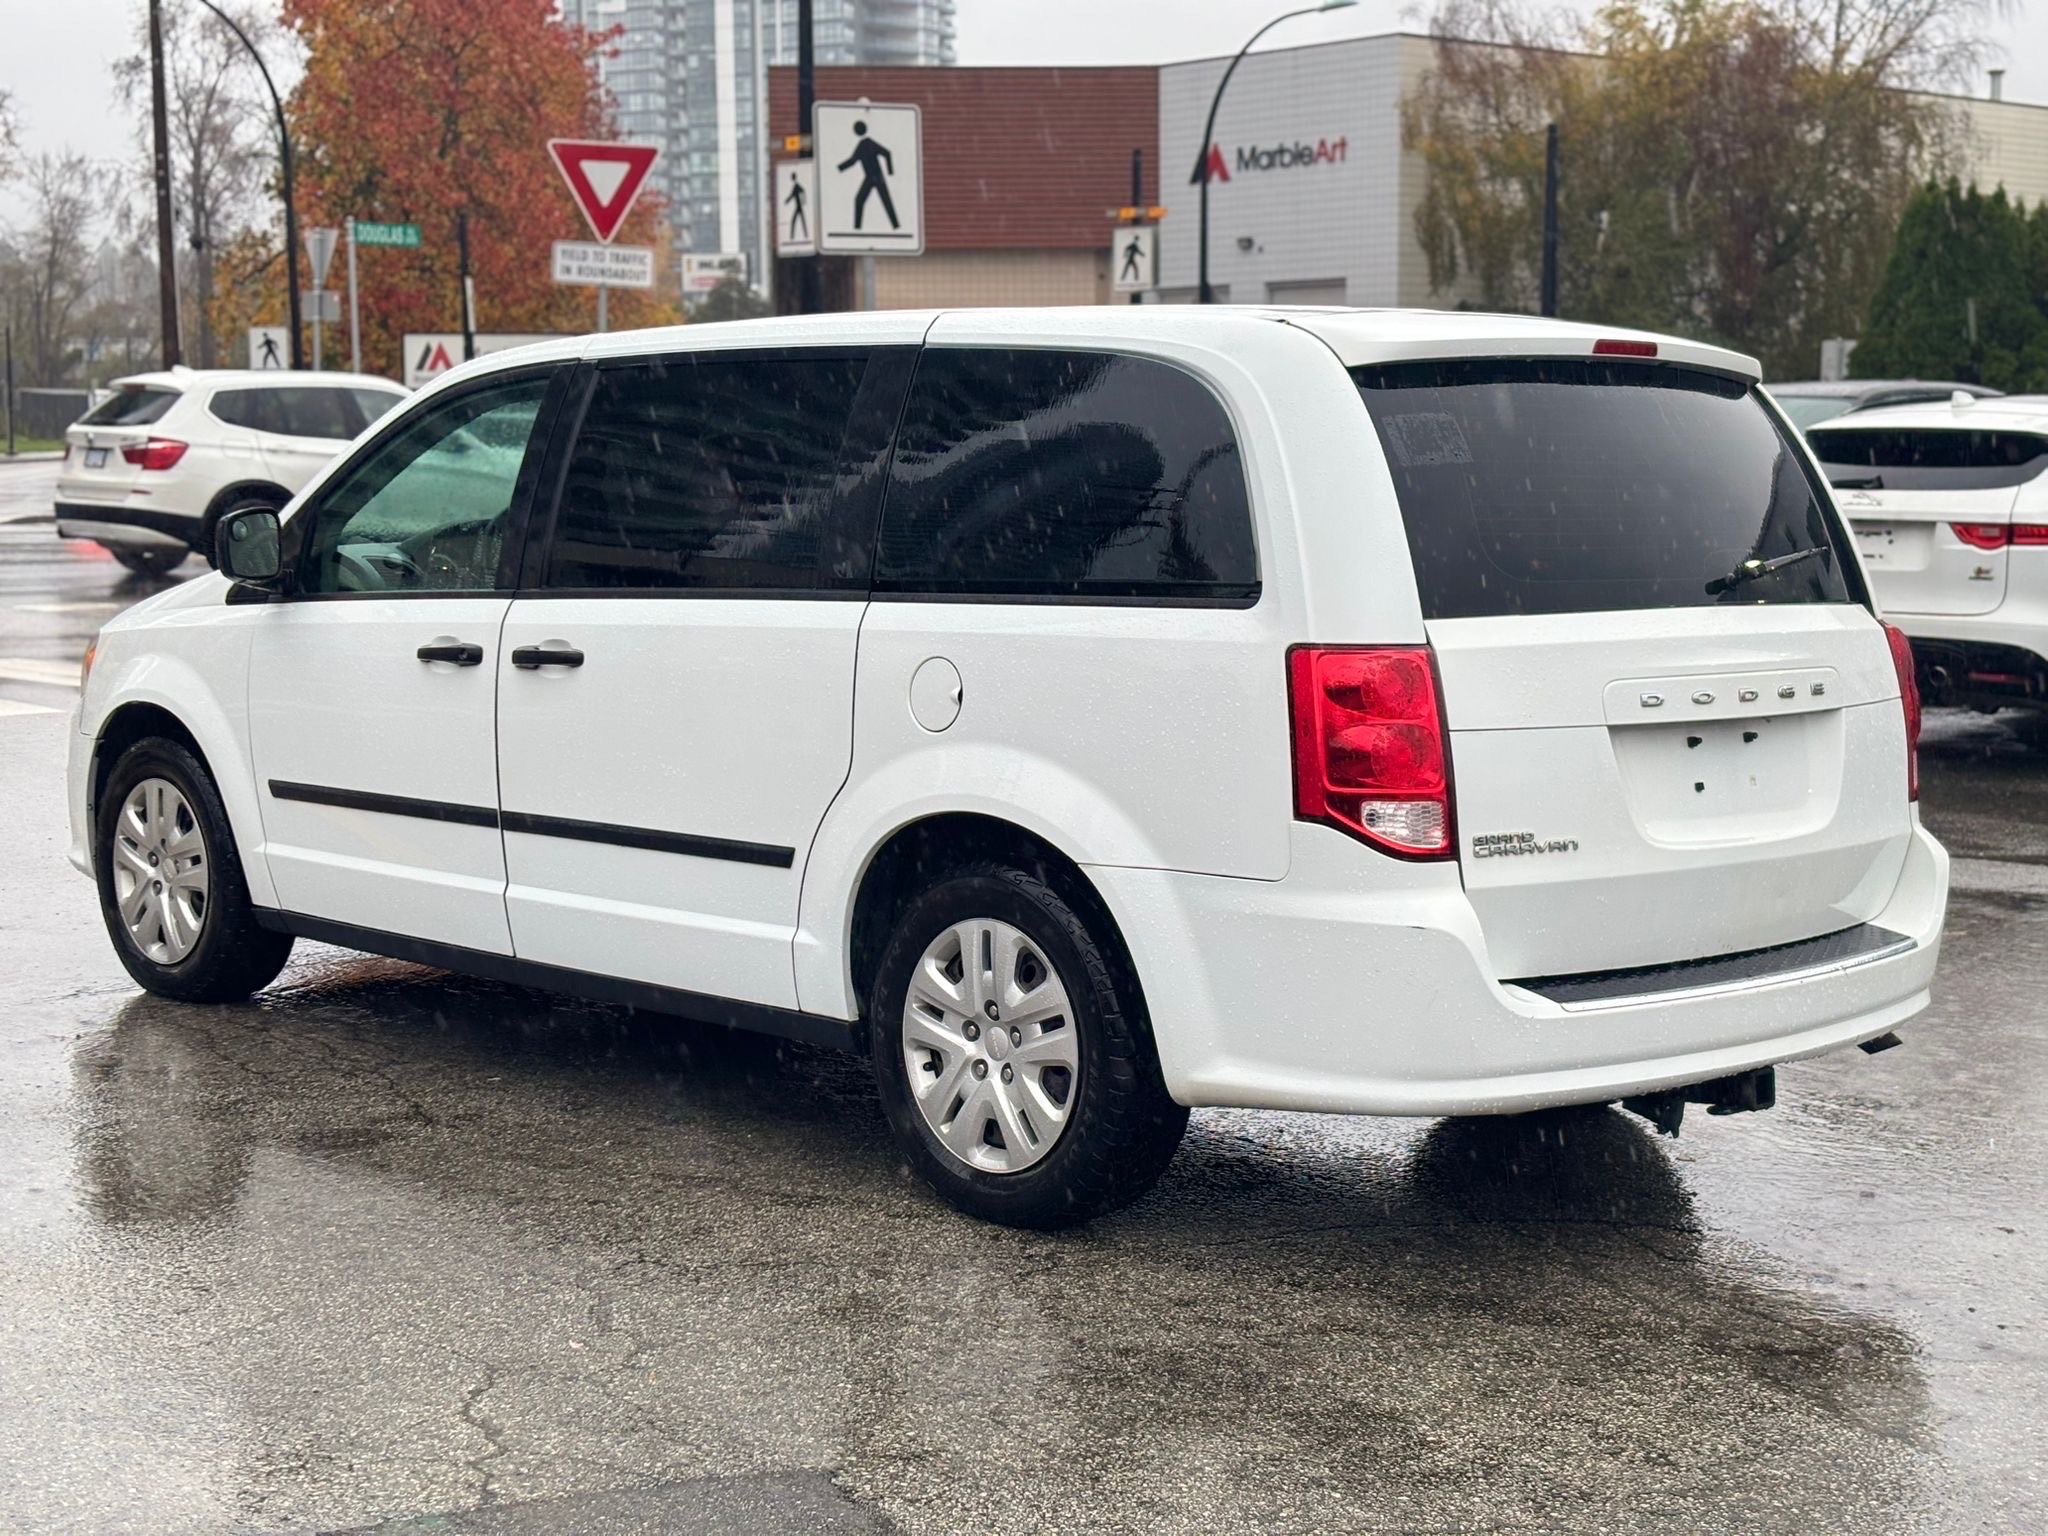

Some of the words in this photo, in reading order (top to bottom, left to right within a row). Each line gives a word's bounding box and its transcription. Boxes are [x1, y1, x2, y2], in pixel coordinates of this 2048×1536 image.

[1237, 135, 1347, 172] MarbleArt
[357, 224, 403, 244] DOUGLAS
[561, 247, 589, 262] YIELD
[592, 250, 606, 263] TO
[609, 251, 648, 267] TRAFFIC
[561, 264, 572, 276] IN
[577, 265, 648, 282] ROUNDABOUT
[1640, 682, 1825, 708] DODGE
[1473, 832, 1534, 847] GRAND
[1473, 840, 1579, 858] CARAVAN
